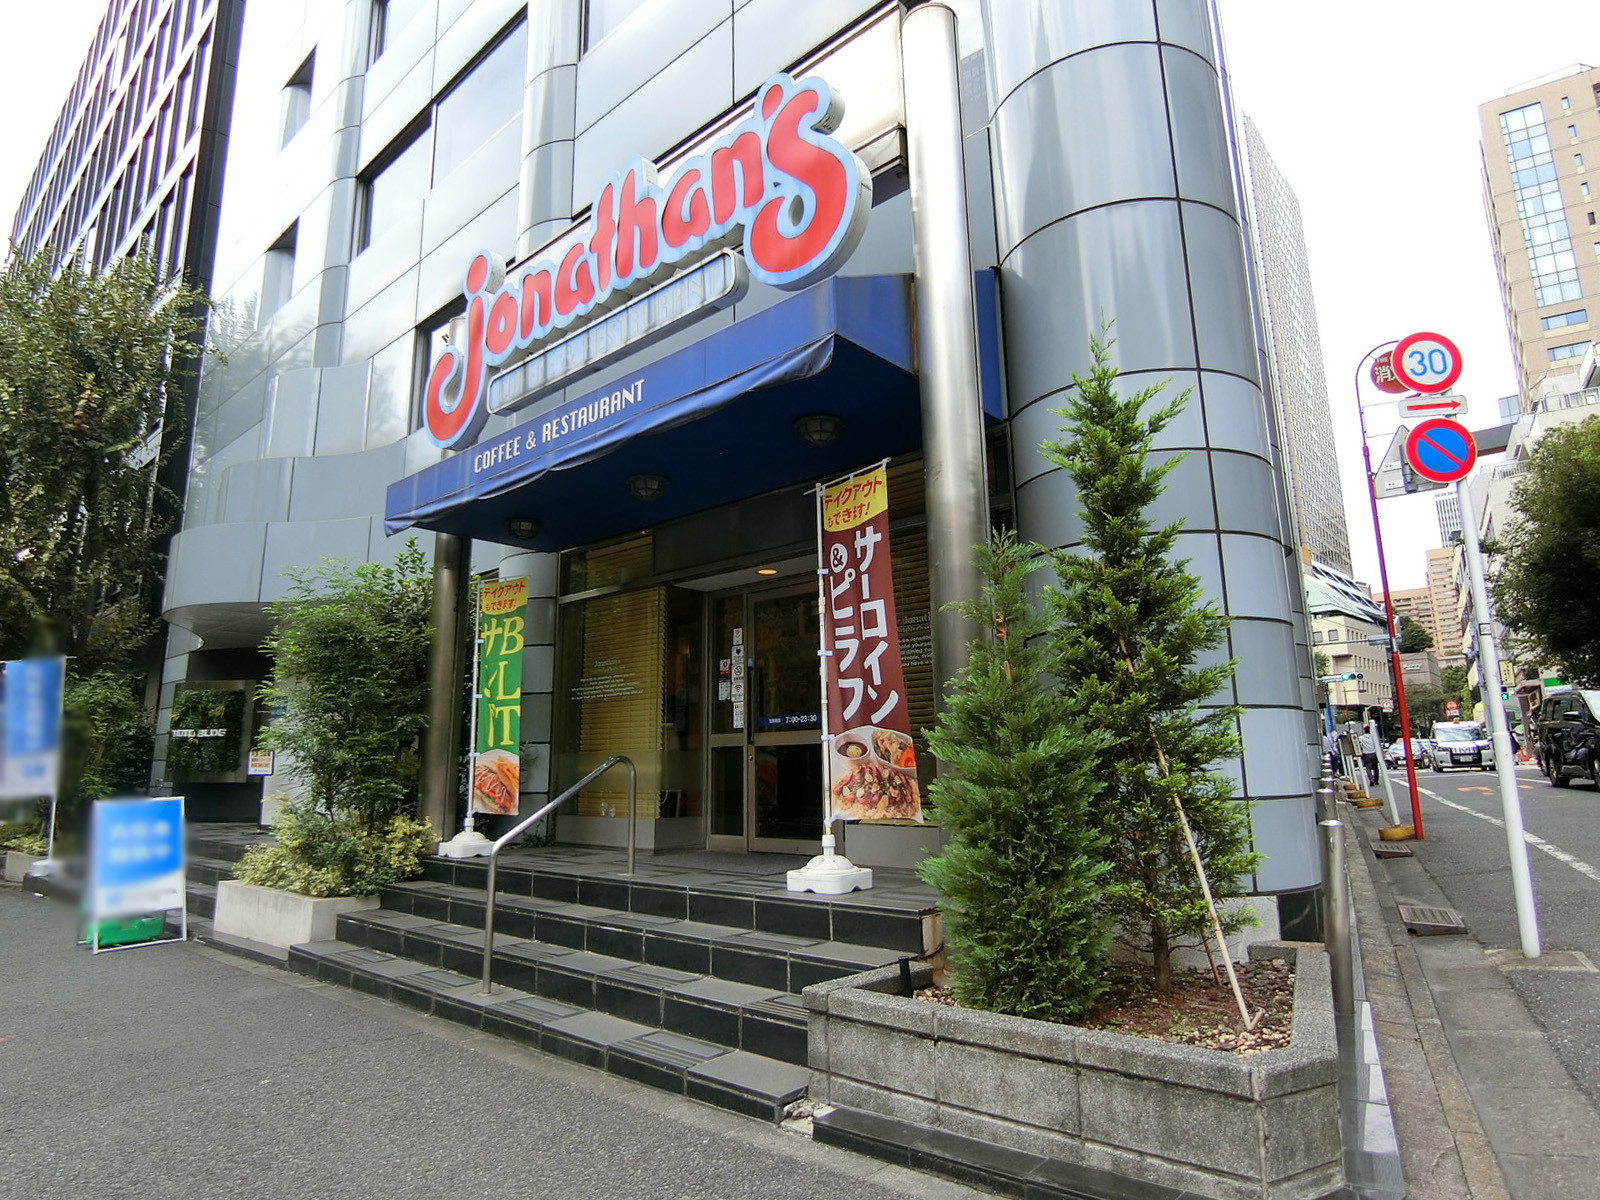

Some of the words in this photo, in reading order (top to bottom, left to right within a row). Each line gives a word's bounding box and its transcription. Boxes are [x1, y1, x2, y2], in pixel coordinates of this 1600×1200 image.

[1374, 365, 1396, 384] 消
[1409, 348, 1447, 377] 30
[474, 435, 521, 474] COFFEE
[525, 430, 537, 450] &
[541, 378, 647, 444] RESTAURANT
[824, 475, 883, 511] テイクアウト
[483, 580, 526, 599] テイクアウト
[855, 525, 899, 725] サーロイン
[494, 615, 525, 747] BLT
